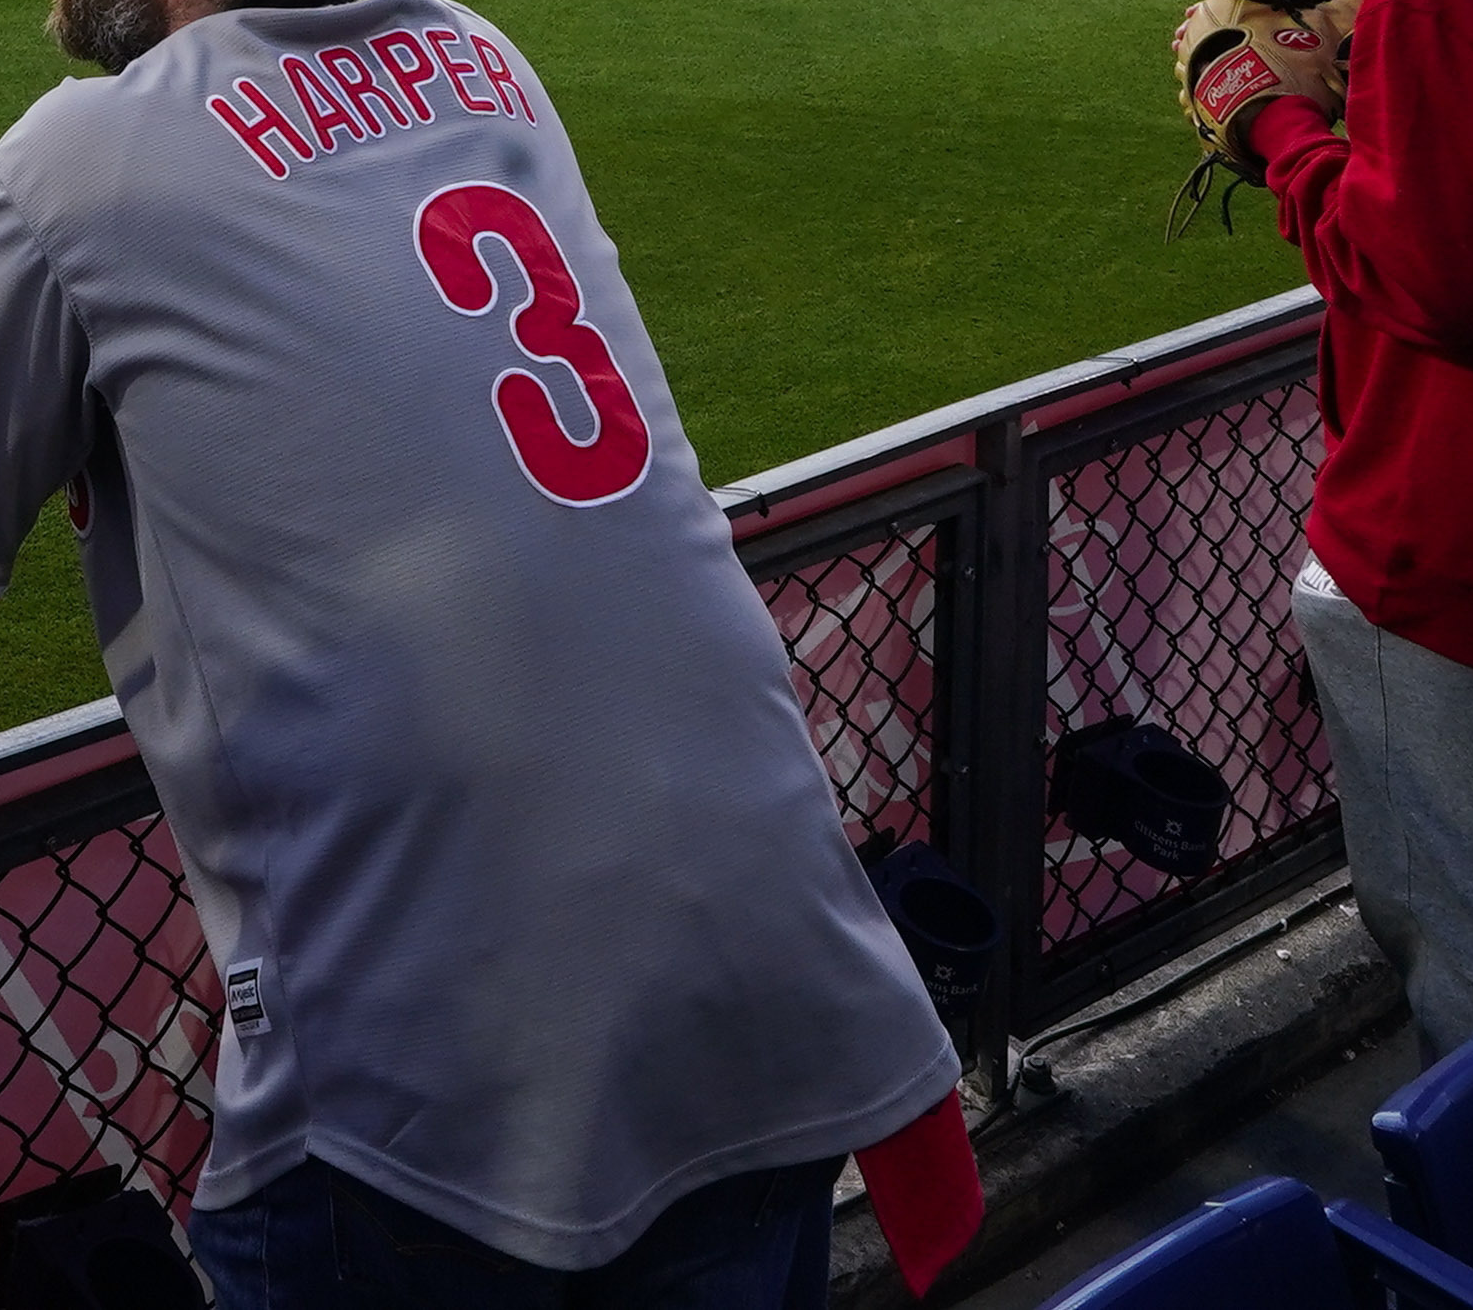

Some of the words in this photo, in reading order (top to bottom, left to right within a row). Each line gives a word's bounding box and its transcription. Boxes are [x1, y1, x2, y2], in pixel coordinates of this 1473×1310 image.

[206, 25, 540, 181] HARPER
[1207, 57, 1256, 107] Rawlings
[413, 179, 653, 509] 3
[1133, 819, 1179, 851] Citizens
[1152, 843, 1180, 861] Park
